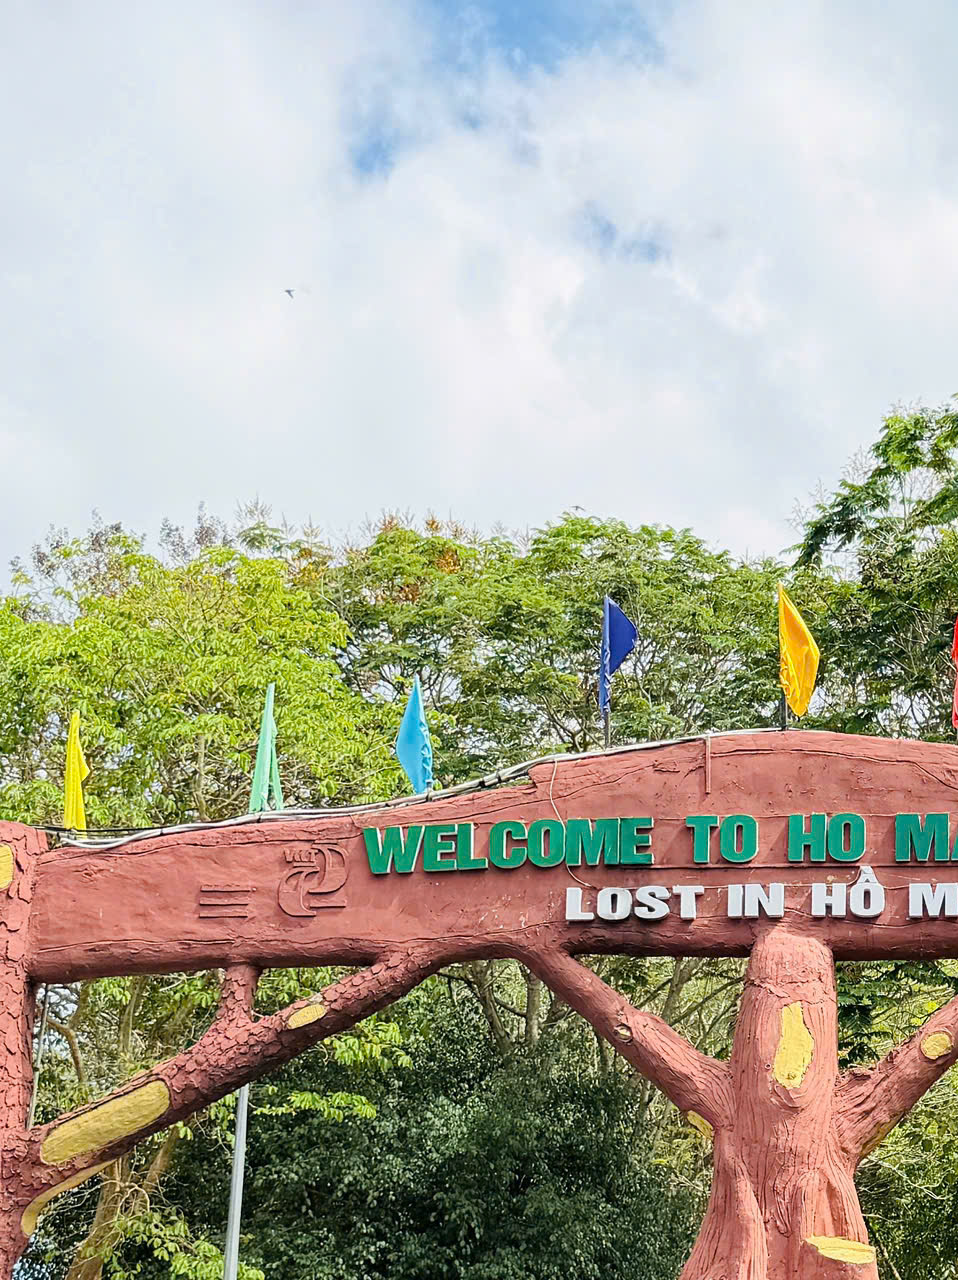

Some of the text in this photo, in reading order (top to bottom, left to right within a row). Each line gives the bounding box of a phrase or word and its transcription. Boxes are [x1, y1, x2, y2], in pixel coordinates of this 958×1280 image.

[363, 816, 655, 875] WELCOME
[685, 814, 760, 864] TO
[787, 811, 867, 862] HO
[564, 885, 706, 923] LOST
[726, 882, 786, 919] IN
